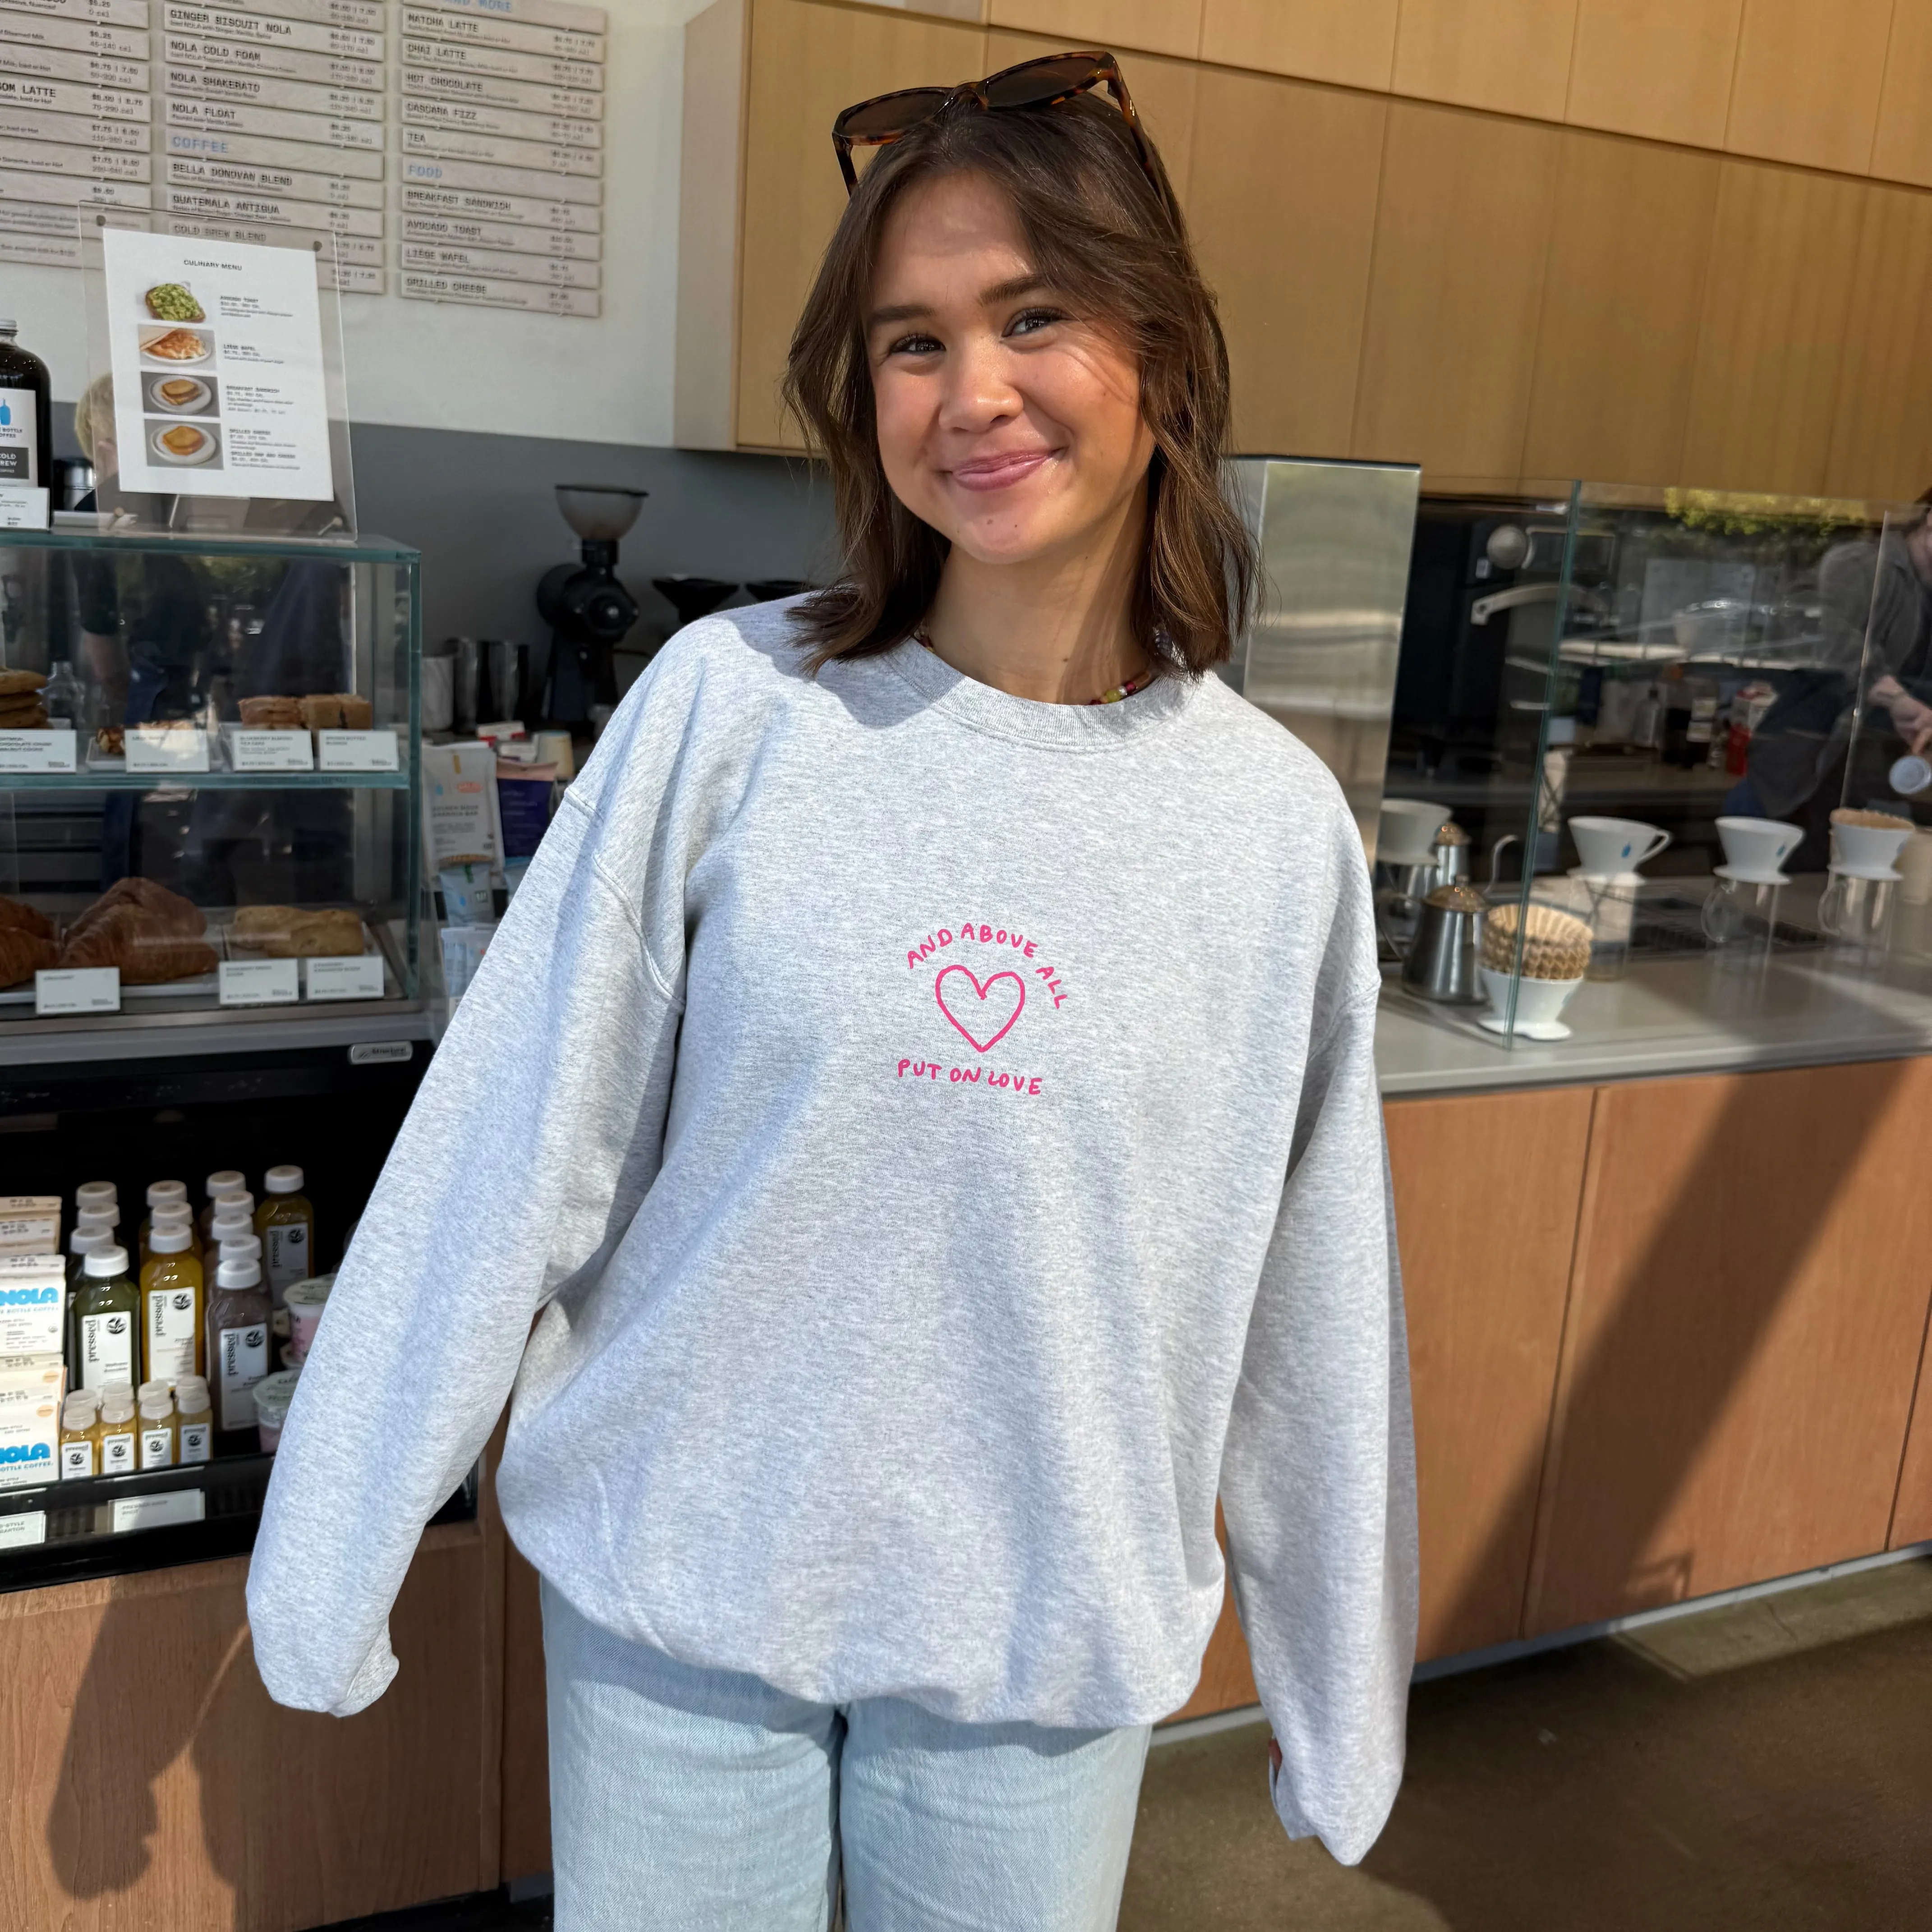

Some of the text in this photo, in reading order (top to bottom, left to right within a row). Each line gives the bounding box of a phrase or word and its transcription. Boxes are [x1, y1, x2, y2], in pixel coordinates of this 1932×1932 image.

[479, 0, 511, 13] MORE
[170, 9, 209, 22] GINGER
[216, 15, 258, 30] BISCUIT
[267, 23, 292, 35] NOLA
[409, 13, 478, 32] MATCHA LATTE
[171, 40, 261, 61] NOLA COLD FOAM
[438, 47, 466, 60] LATTE
[171, 72, 197, 83] NOLA
[203, 77, 260, 93] SHAKERATO
[408, 72, 483, 92] HOT CHOCOLATE
[23, 85, 56, 97] LATTE
[172, 103, 236, 119] NOLA FLOAT
[407, 102, 477, 120] CASCARA FIZZ
[173, 136, 229, 153] COFFEE
[407, 133, 426, 143] TEA
[173, 163, 205, 175] BELLA
[211, 168, 256, 181] DONOVAN
[261, 174, 293, 186] BLEND
[409, 165, 443, 178] FOOD
[173, 195, 230, 208] GUATEMALA
[236, 202, 280, 215] ANTIGUA
[407, 191, 459, 204] BREAKFAST
[465, 197, 511, 211] SANDWICH
[175, 225, 267, 242] COLD BREW BLEND
[407, 219, 481, 235] AVOCADO TOAST
[184, 260, 220, 268] CULINARY
[407, 277, 487, 294] GRILLED CHEESE
[907, 923, 1067, 1009] AND ABOVE ALL
[898, 1059, 1042, 1095] PUT ON LOVE
